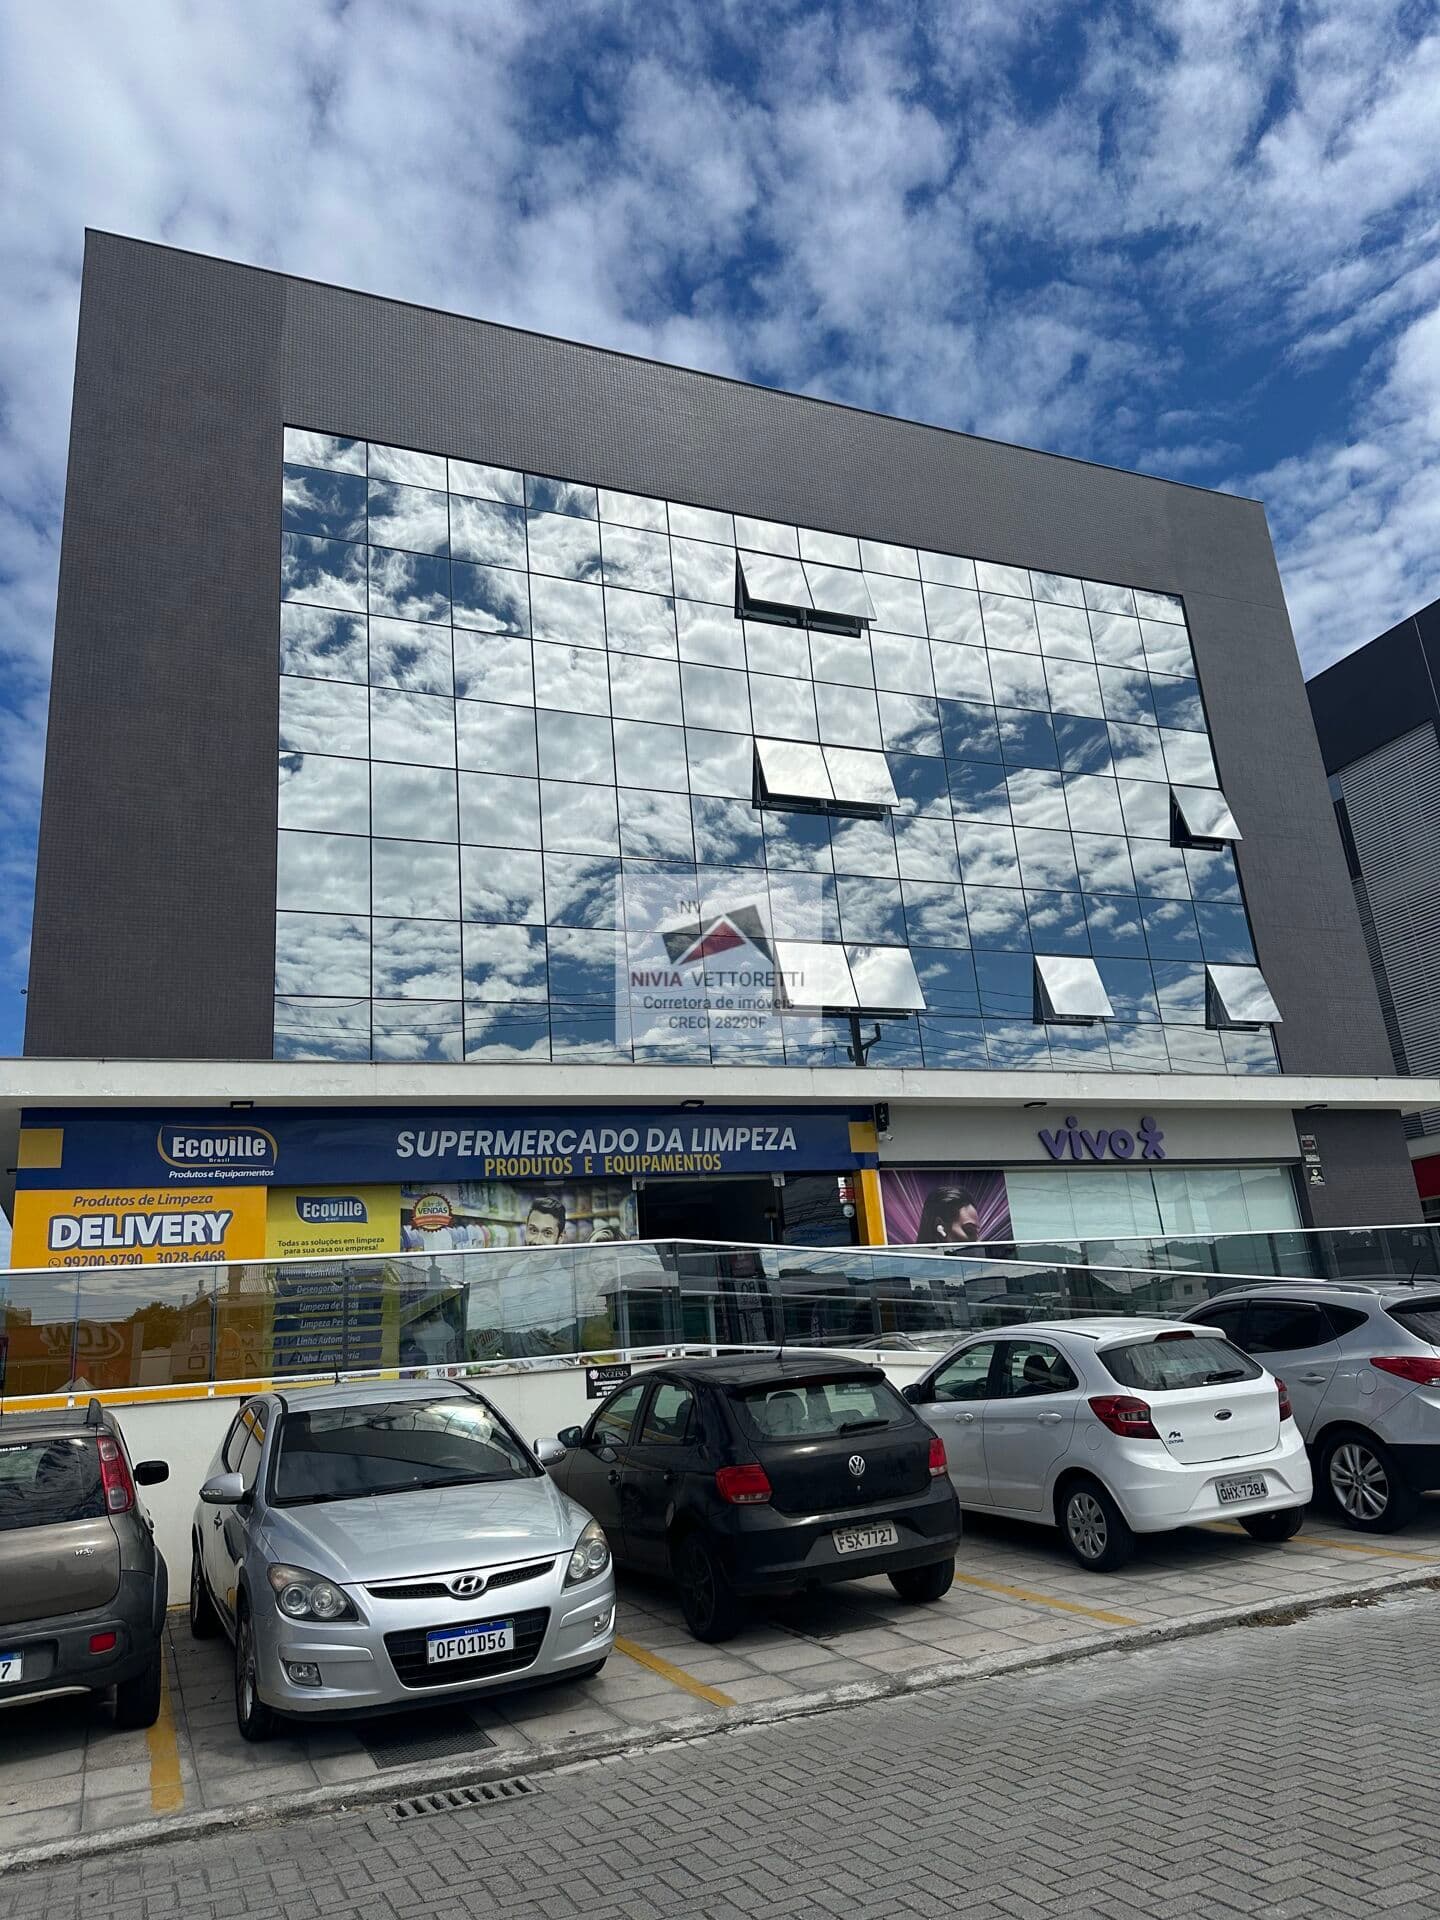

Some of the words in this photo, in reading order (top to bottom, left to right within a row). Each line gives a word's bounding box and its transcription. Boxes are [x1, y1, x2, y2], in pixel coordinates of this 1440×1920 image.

[396, 1128, 640, 1158] SUPERMERCADO
[646, 1127, 684, 1153] DA
[691, 1126, 797, 1152] LIMPEZA
[1038, 1115, 1136, 1160] vivo
[172, 1136, 267, 1158] Ecoville
[168, 1170, 208, 1179] Produtos
[214, 1169, 275, 1179] Equipamentos
[484, 1156, 573, 1177] PRODUTOS
[584, 1156, 594, 1174] E
[605, 1154, 722, 1175] EQUIPAMENTOS
[73, 1194, 135, 1208] Produtos
[138, 1193, 155, 1206] de
[157, 1193, 213, 1208] Limpeza
[303, 1201, 363, 1218] Ecoville
[417, 1207, 448, 1215] VENDAS
[50, 1211, 233, 1249] DELIVERY
[278, 1239, 300, 1248] Todas
[356, 1236, 385, 1245] limpeza
[63, 1253, 143, 1268] 99200-9790
[156, 1249, 226, 1264] 3028-6468
[283, 1247, 301, 1256] para
